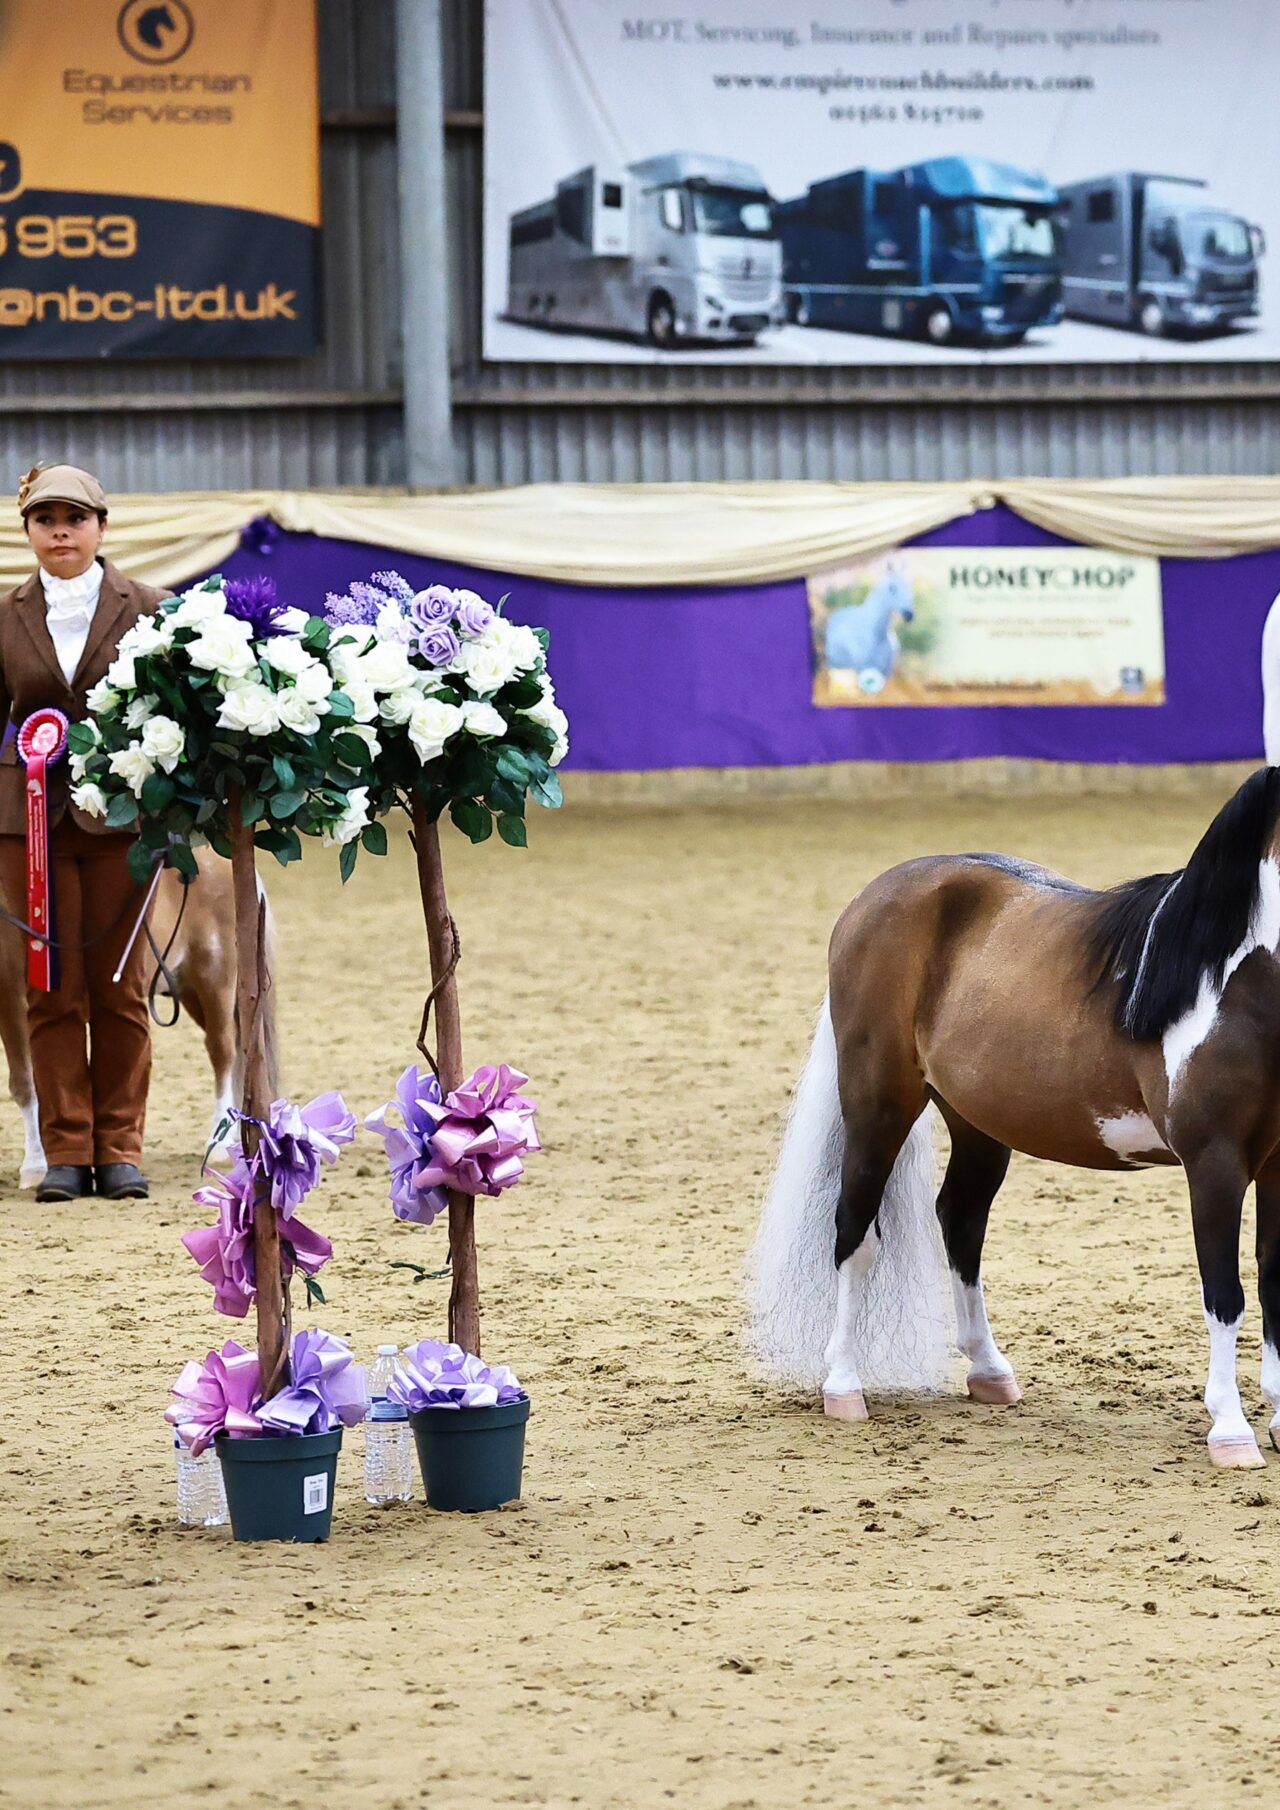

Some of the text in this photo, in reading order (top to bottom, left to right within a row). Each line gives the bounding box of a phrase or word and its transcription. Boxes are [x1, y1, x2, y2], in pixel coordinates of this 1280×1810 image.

[811, 20, 913, 44] Insurance
[921, 22, 963, 44] and
[967, 21, 1048, 50] Repairs
[63, 69, 251, 96] Equestrian
[82, 102, 234, 125] Services
[16, 214, 137, 259] 953
